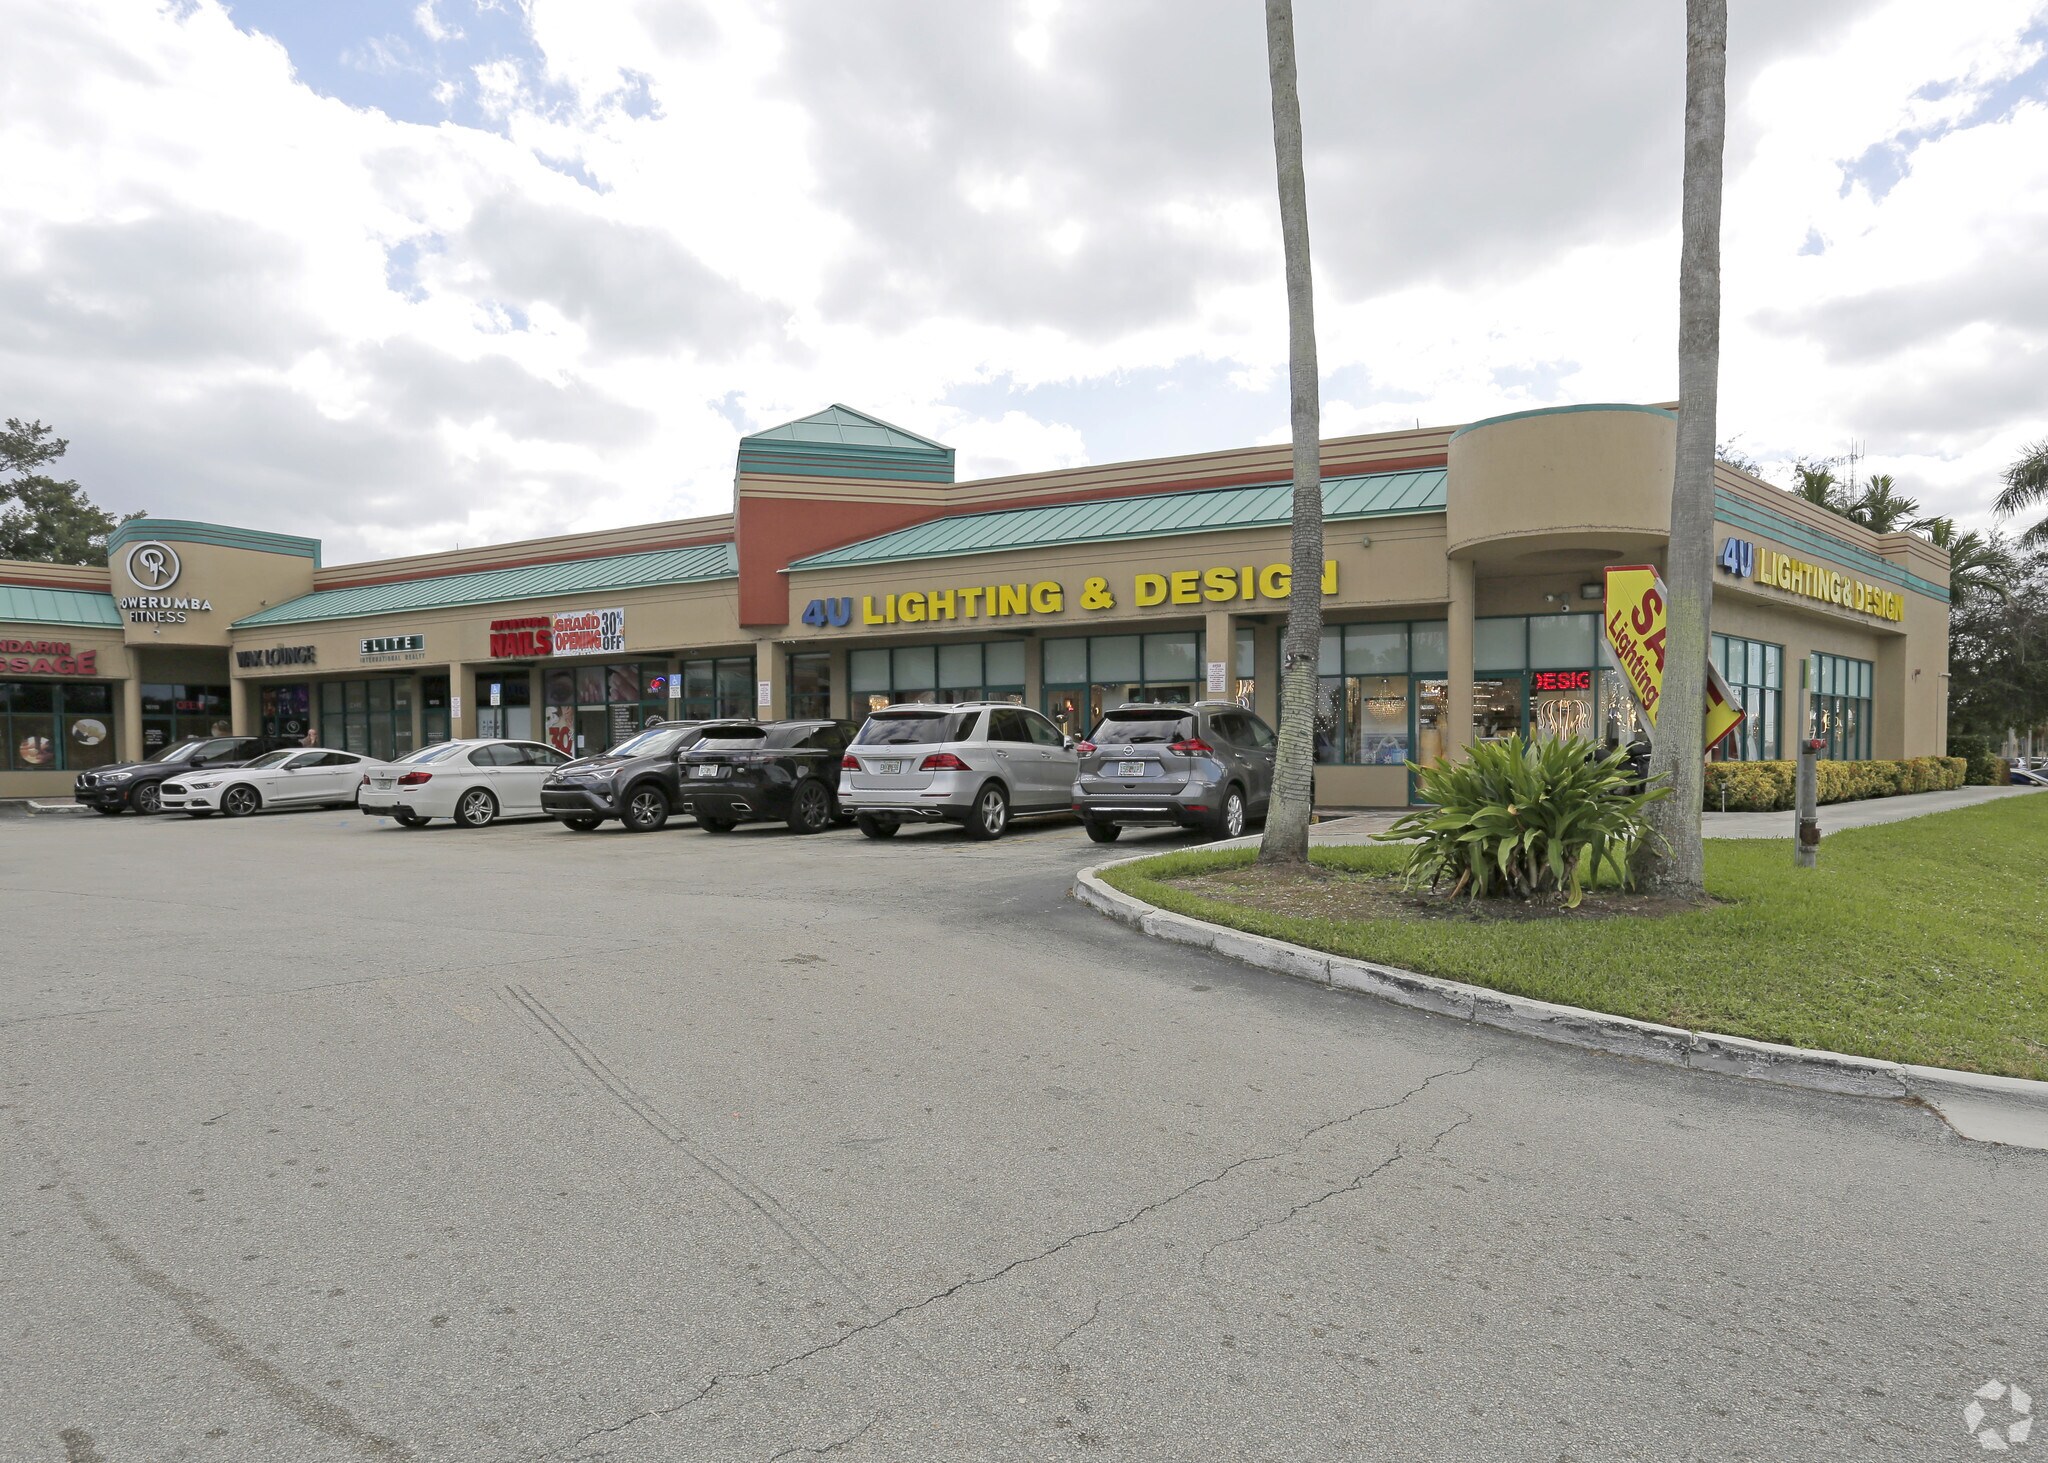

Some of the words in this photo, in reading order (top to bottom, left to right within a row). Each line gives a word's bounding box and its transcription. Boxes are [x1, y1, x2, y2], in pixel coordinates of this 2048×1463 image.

[1722, 537, 1754, 578] 4U
[1754, 547, 1842, 604] LIGHTING
[1841, 576, 1854, 608] &
[1854, 580, 1904, 622] DESIGN
[120, 596, 213, 611] OWERUMBA
[801, 597, 853, 627] 4U
[863, 581, 1064, 625] LIGHTING
[1080, 576, 1117, 610] &
[129, 610, 187, 624] FITNESS
[553, 615, 601, 632] GRAND
[361, 636, 411, 652] ELITE
[490, 629, 553, 657] NAILS
[555, 630, 602, 651] OPENING
[602, 635, 622, 651] OFF
[1608, 609, 1659, 711] Lighting
